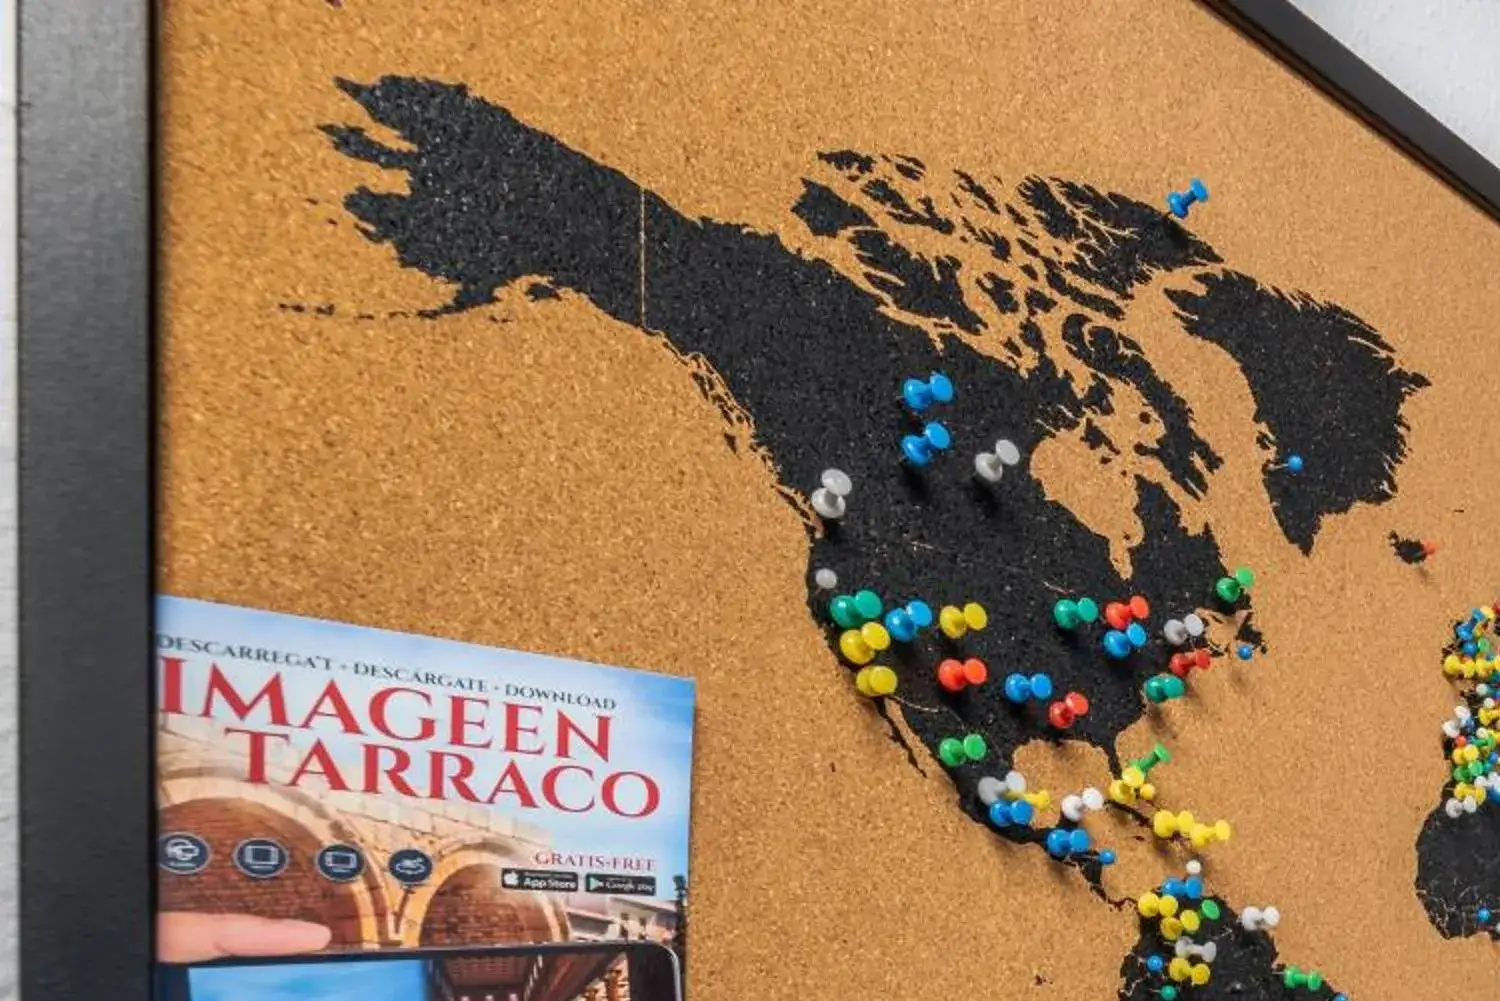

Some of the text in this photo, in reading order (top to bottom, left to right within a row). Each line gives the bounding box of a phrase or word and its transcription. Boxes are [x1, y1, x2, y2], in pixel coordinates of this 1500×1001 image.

[158, 654, 612, 763] IMAGEEN
[504, 683, 617, 711] DOWNLOAD
[223, 727, 660, 819] TARRACO
[523, 876, 577, 890] App Store
